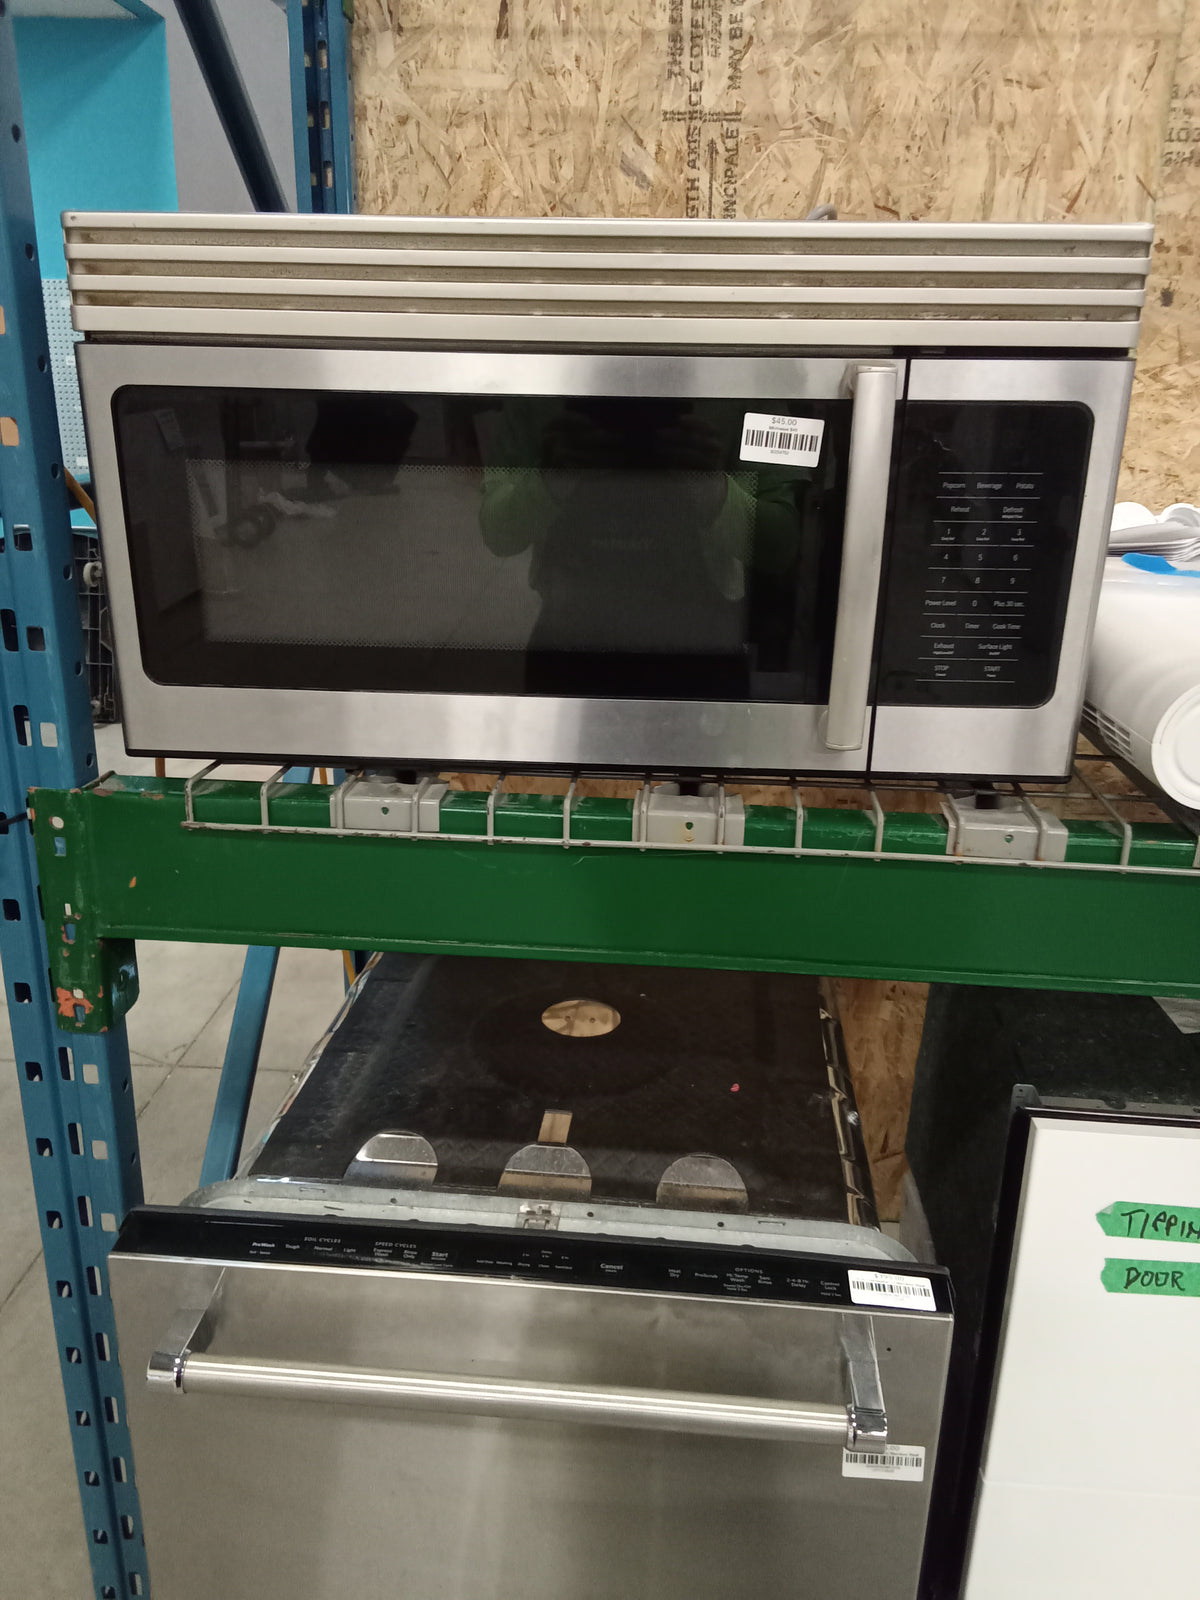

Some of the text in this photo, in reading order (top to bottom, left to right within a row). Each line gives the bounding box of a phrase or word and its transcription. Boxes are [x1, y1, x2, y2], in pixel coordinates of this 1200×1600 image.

[771, 416, 798, 426] $45.00
[976, 482, 1002, 490] Beverage
[981, 528, 987, 536] 2
[1013, 553, 1019, 561] 6
